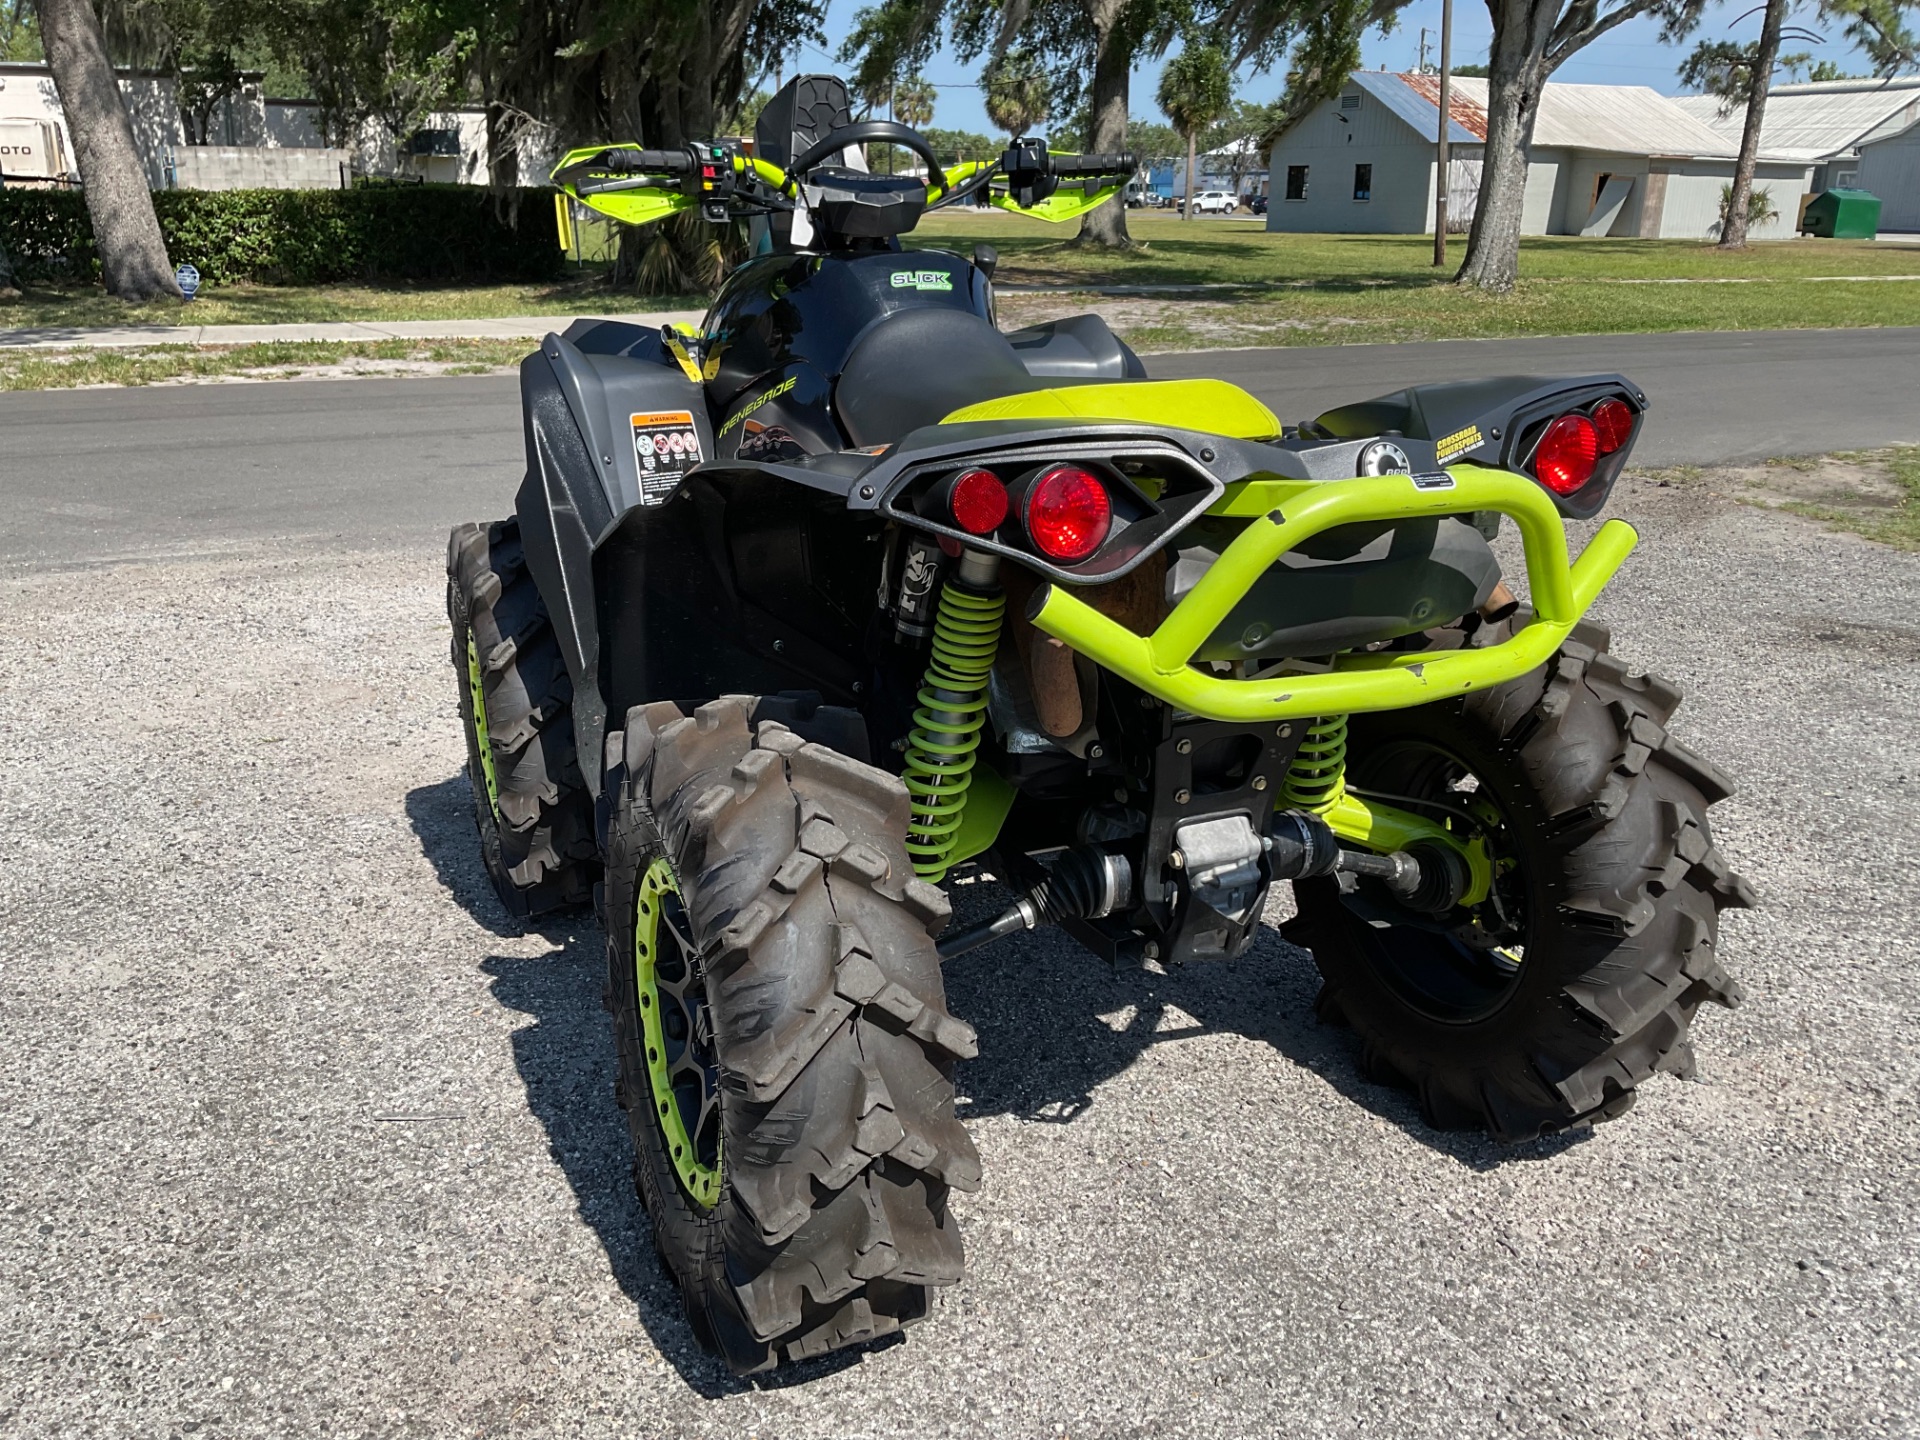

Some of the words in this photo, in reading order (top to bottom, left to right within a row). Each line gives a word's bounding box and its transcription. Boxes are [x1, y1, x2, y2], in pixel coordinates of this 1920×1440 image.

[893, 274, 946, 284] SLICK
[719, 376, 796, 439] RENEGADE
[1436, 432, 1482, 460] POWERSPORTS
[1437, 425, 1477, 450] CROSSROAD
